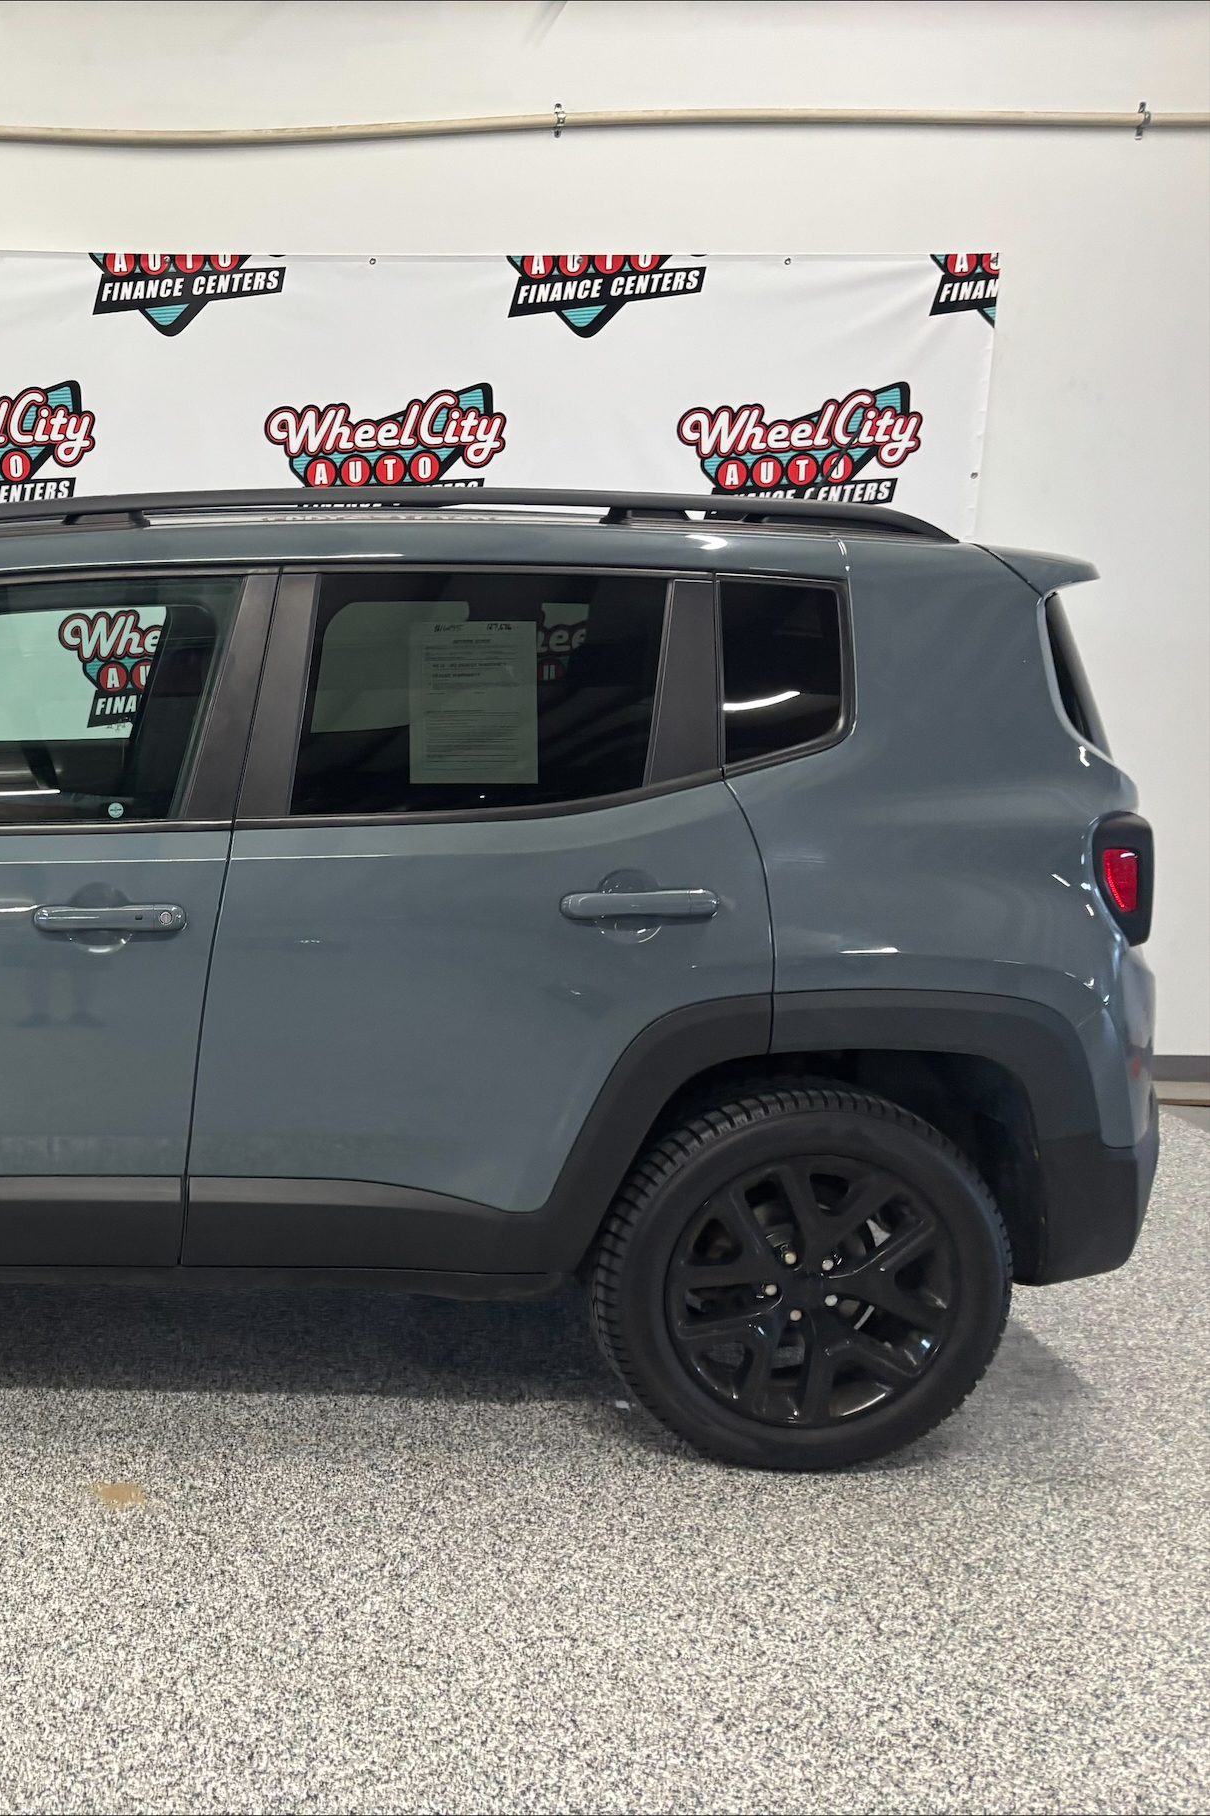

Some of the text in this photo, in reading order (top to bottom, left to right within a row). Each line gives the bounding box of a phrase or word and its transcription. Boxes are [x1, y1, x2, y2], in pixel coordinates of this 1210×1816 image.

[101, 270, 280, 302] FINANCE CENTERS
[516, 270, 700, 305] FINANCE CENTERS
[938, 278, 999, 303] FINAN
[314, 456, 432, 485] AUTO
[725, 456, 845, 486] AUTO
[63, 614, 161, 659] Whe
[106, 665, 151, 689] AU
[95, 695, 137, 716] FINA
